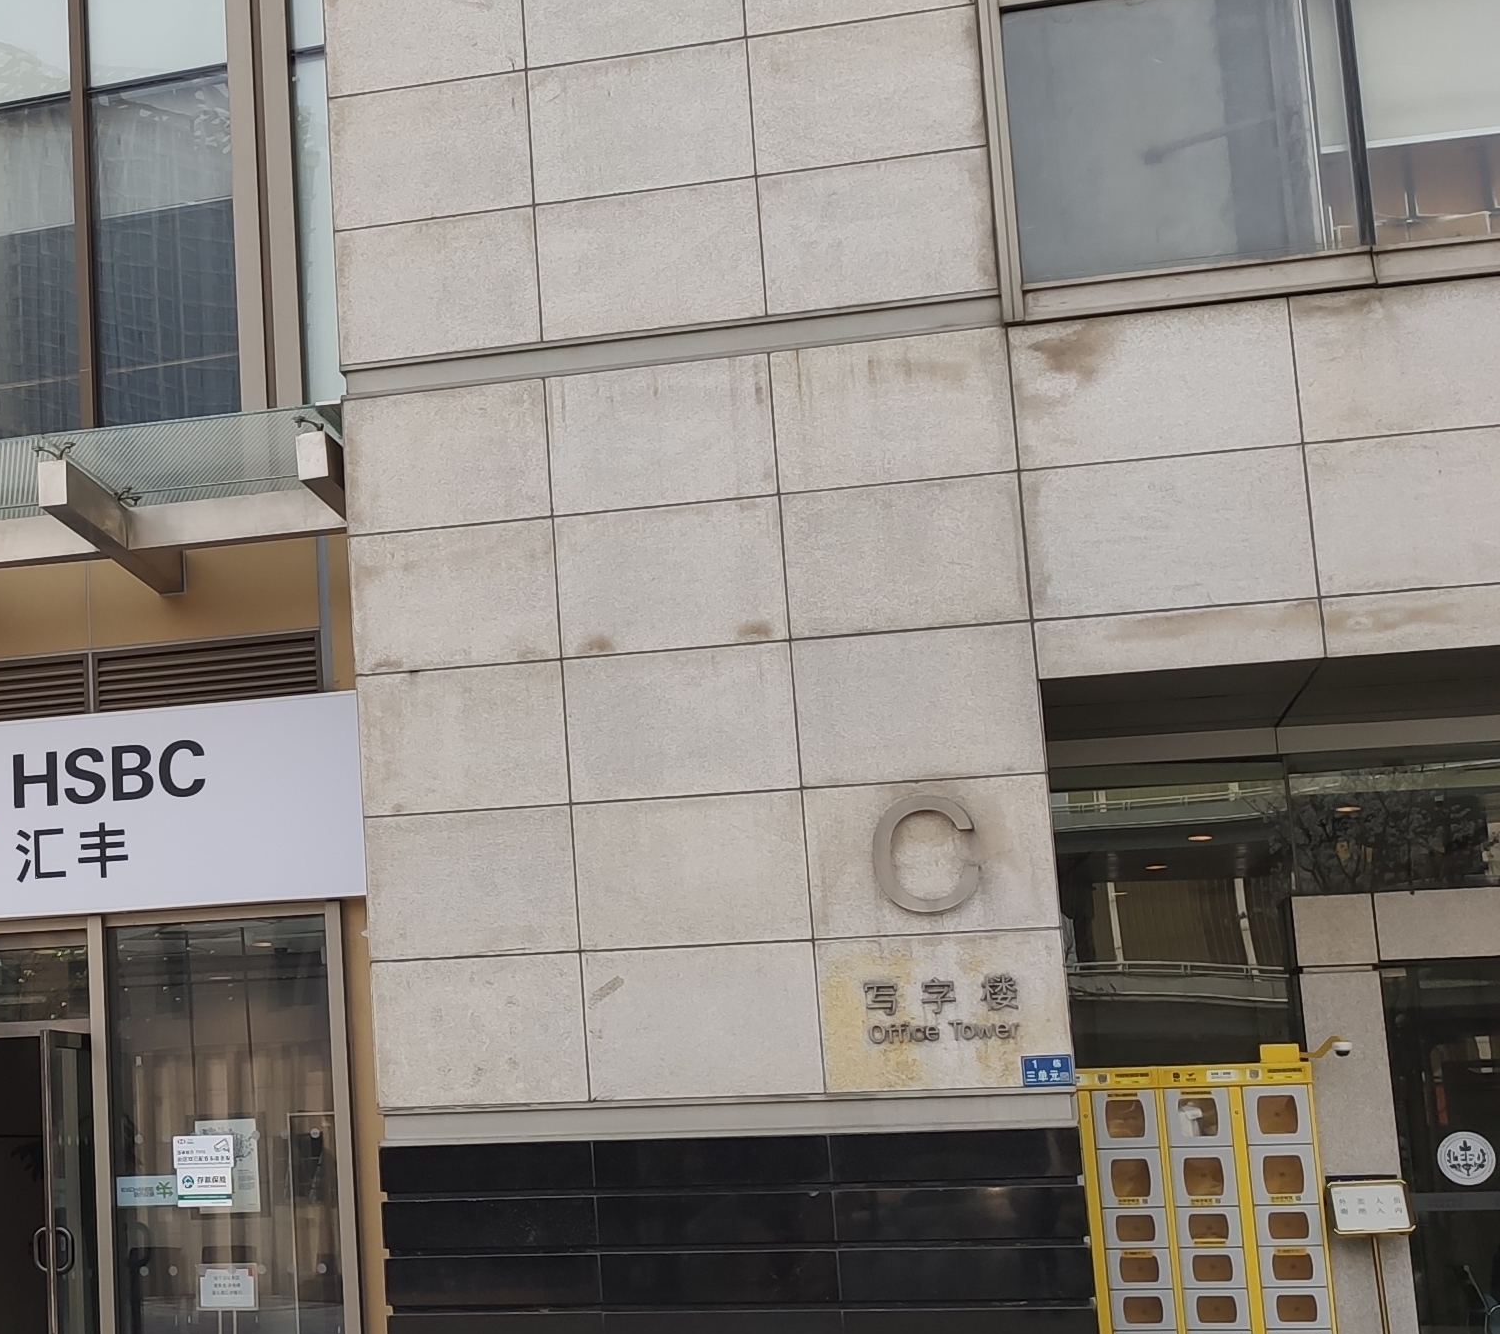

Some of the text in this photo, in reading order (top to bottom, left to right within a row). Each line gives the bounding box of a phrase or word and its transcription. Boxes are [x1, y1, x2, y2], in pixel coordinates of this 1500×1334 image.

[13, 739, 207, 809] HSBC
[14, 821, 130, 883] 汇丰
[872, 794, 981, 915] C
[862, 972, 1020, 1017] 写字楼
[867, 1019, 1021, 1045] Office Tower
[1025, 1069, 1061, 1082] 三单元
